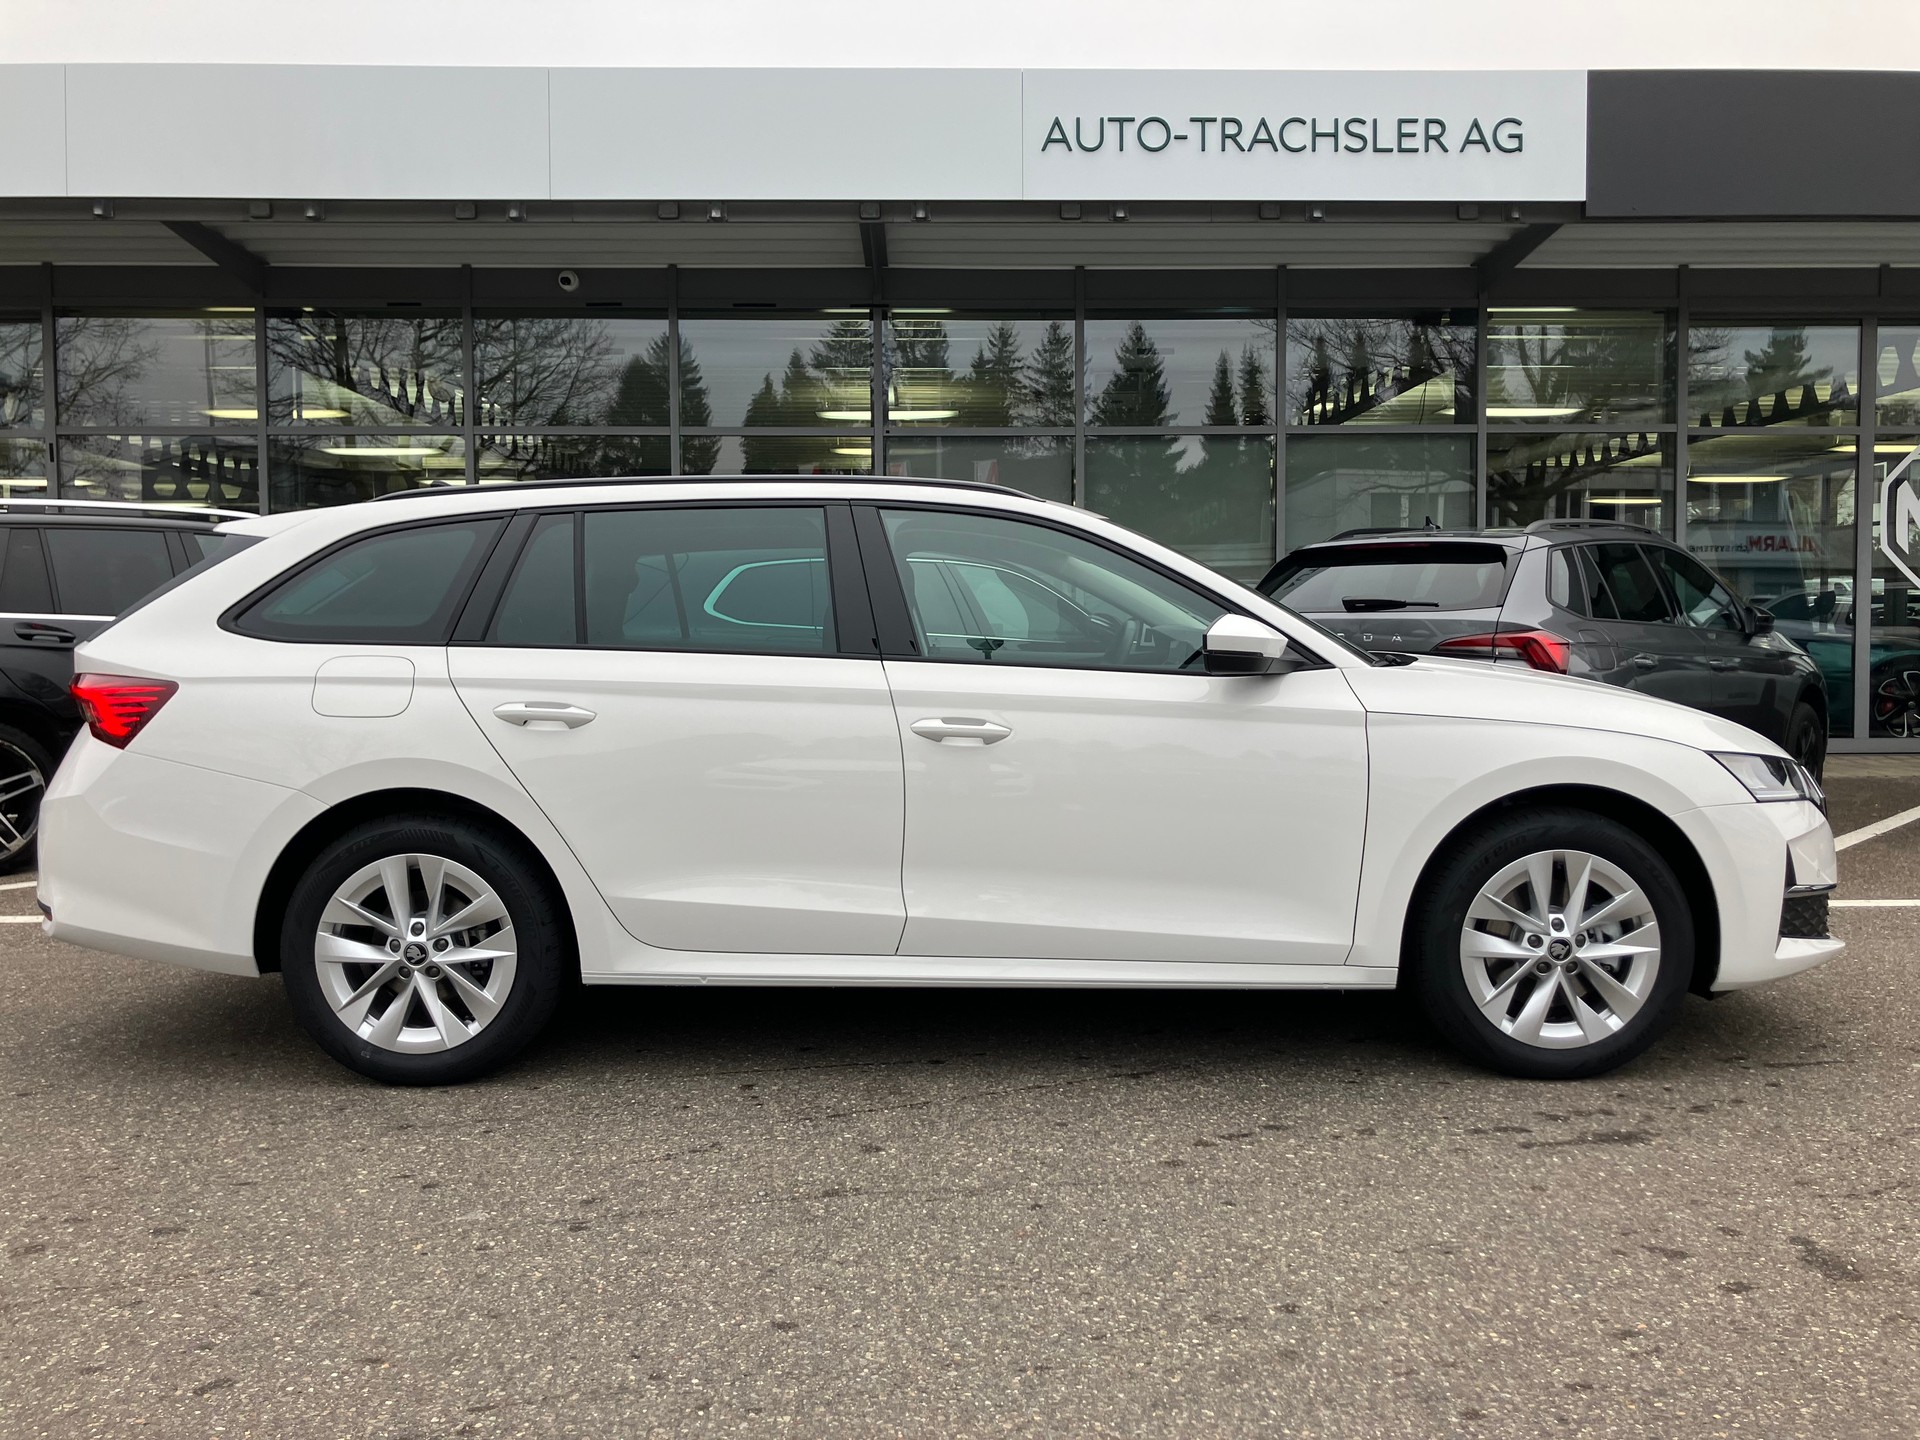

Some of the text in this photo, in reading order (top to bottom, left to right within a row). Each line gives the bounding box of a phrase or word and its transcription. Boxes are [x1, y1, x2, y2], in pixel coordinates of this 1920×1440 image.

[1040, 116, 1524, 154] AUTO-TRACHSLER AG
[1337, 632, 1402, 642] DA
